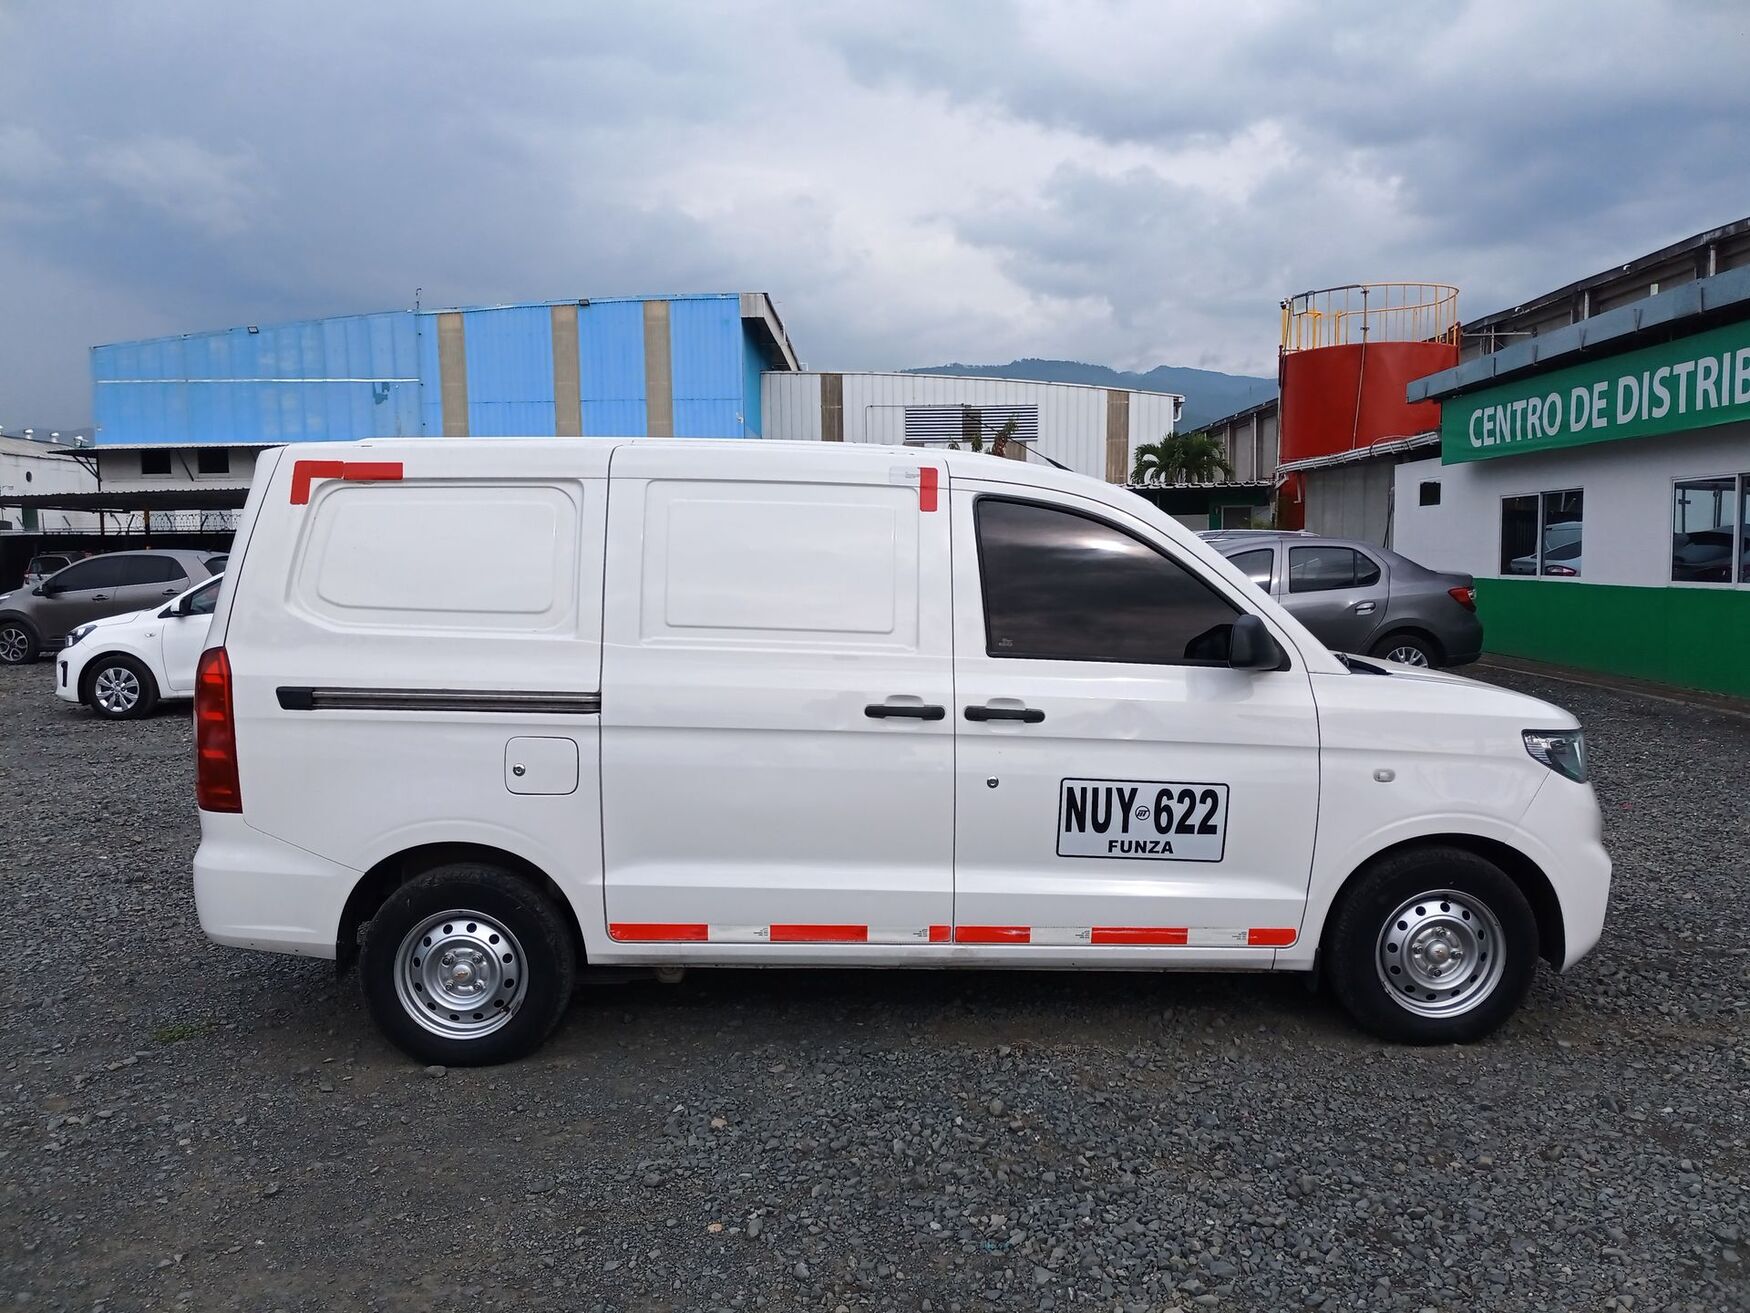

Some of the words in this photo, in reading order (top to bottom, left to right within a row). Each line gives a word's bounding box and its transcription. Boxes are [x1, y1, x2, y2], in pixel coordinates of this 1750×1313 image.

[1469, 392, 1563, 448] CENTRO
[1569, 381, 1609, 433] DE
[1616, 347, 1750, 425] DISTRIB
[1065, 786, 1139, 834] NUY
[1153, 788, 1219, 835] 622
[1107, 840, 1174, 854] FUNZA
